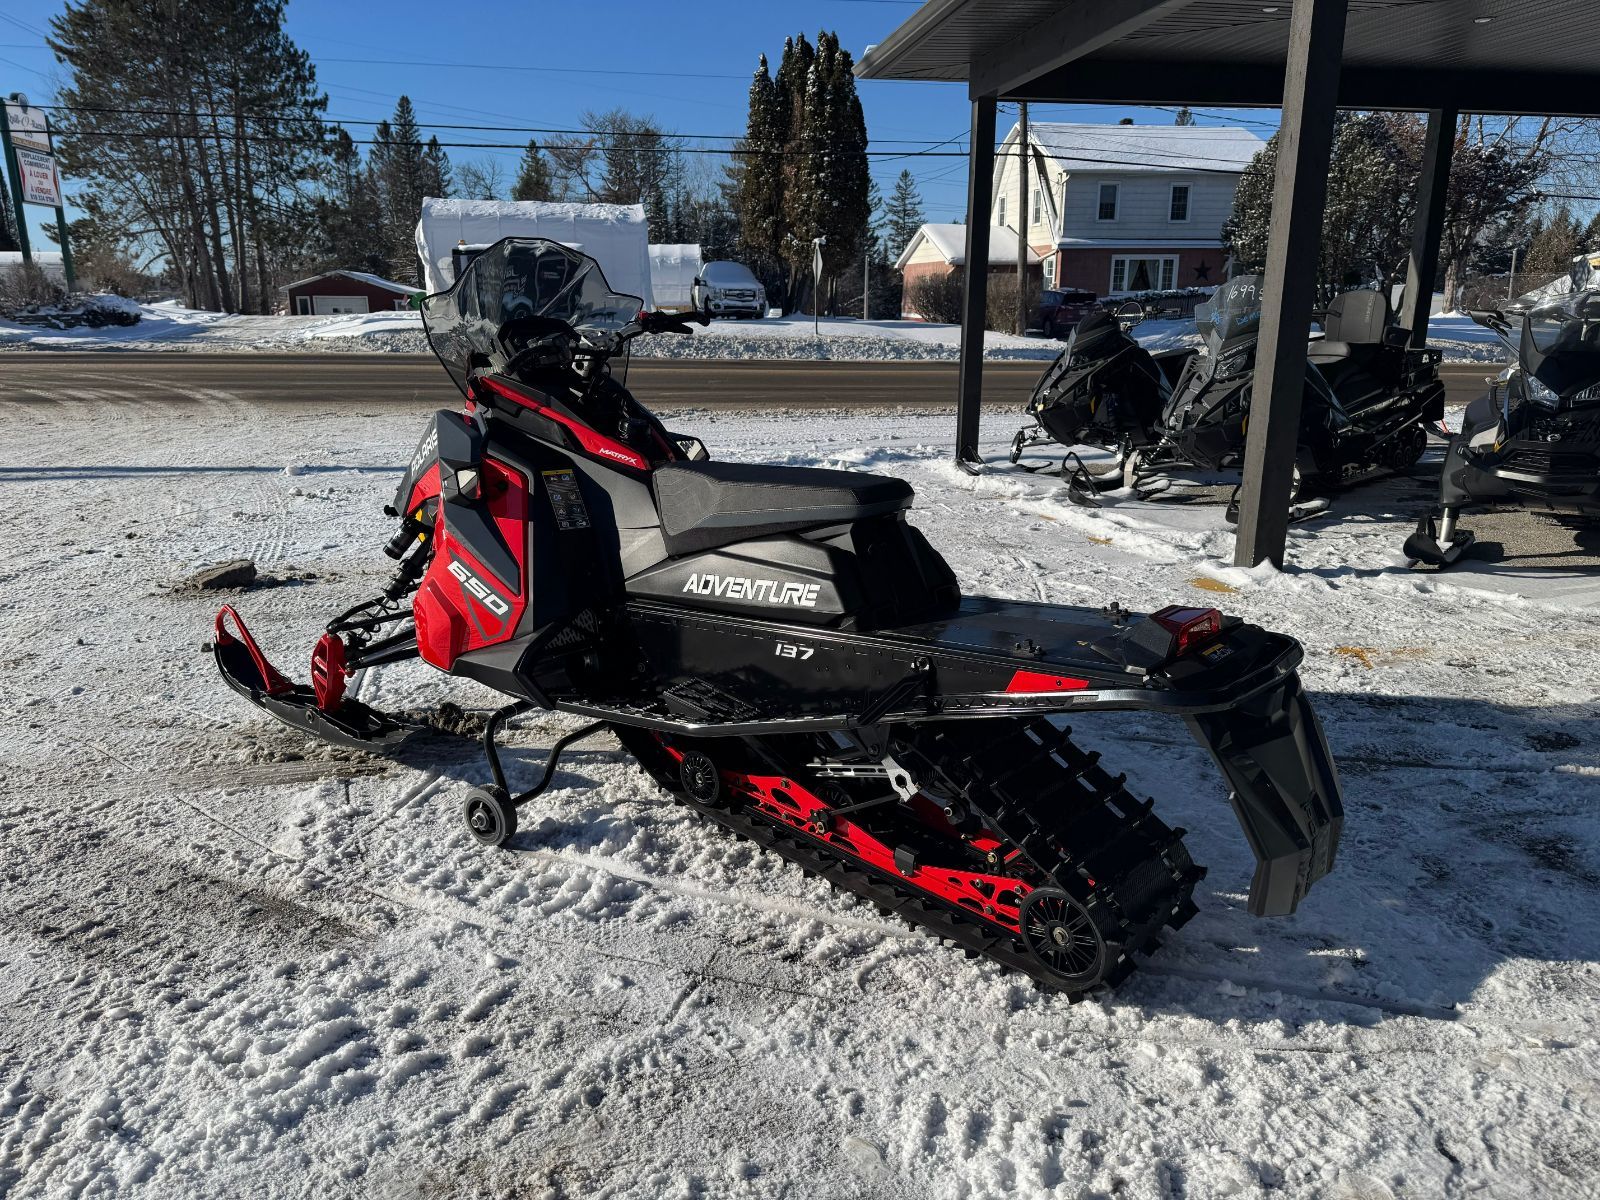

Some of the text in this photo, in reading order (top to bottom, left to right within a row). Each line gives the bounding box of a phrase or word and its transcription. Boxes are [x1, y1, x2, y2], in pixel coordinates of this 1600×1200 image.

[21, 152, 50, 163] EMPLACEMENT
[34, 171, 48, 179] LOUER
[35, 187, 51, 195] VENDRE
[411, 427, 438, 477] POLARIS
[599, 447, 637, 465] MATRYX
[446, 560, 509, 616] 650
[682, 572, 821, 607] ADVENTURE
[774, 643, 815, 660] 137
